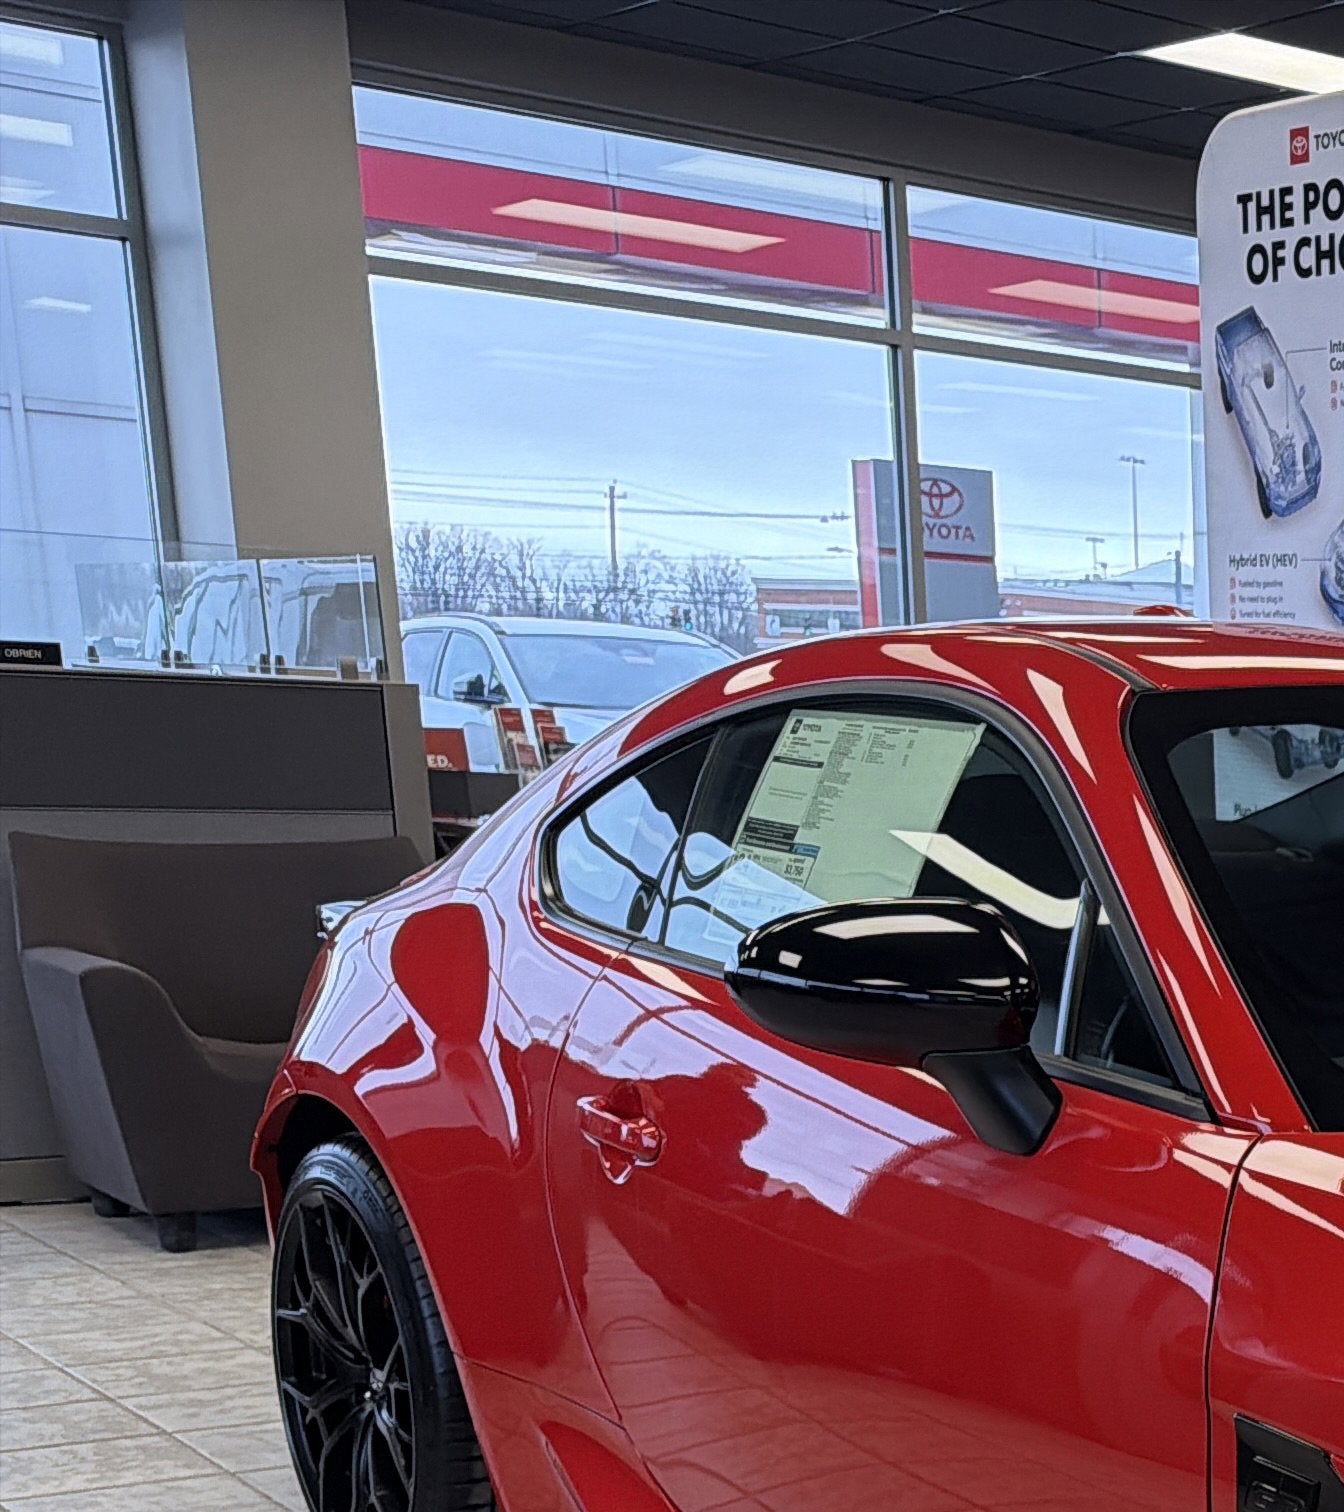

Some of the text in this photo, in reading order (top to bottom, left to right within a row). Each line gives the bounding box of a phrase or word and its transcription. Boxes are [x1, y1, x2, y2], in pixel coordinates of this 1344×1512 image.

[1236, 186, 1294, 234] THE
[1246, 240, 1287, 285] OF
[922, 521, 976, 541] YOTA
[1229, 553, 1298, 571] Hybrid EV (HEV)
